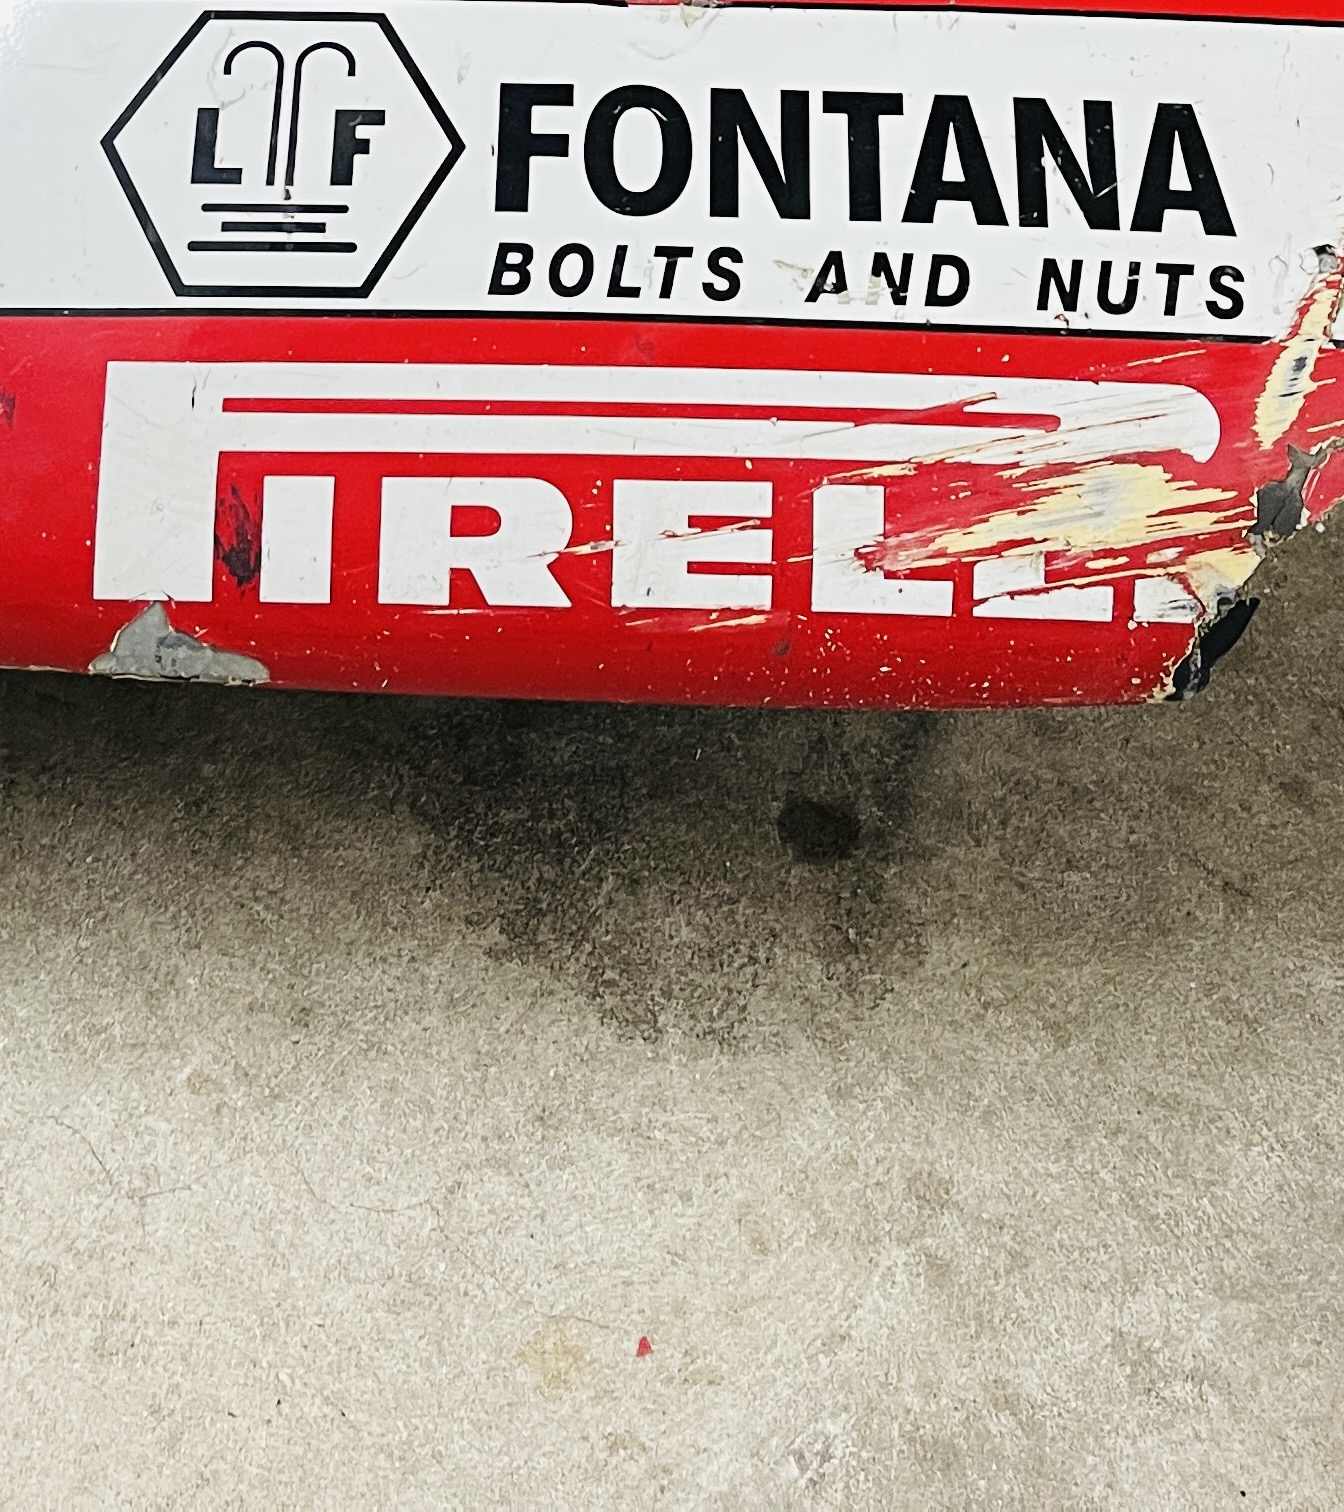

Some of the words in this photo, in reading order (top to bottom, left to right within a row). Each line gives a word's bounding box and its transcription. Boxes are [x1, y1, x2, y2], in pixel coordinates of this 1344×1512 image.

[493, 83, 1238, 237] FONTANA
[488, 242, 744, 301] BOLTS
[804, 251, 971, 307] AND
[1036, 260, 1246, 320] NUTS
